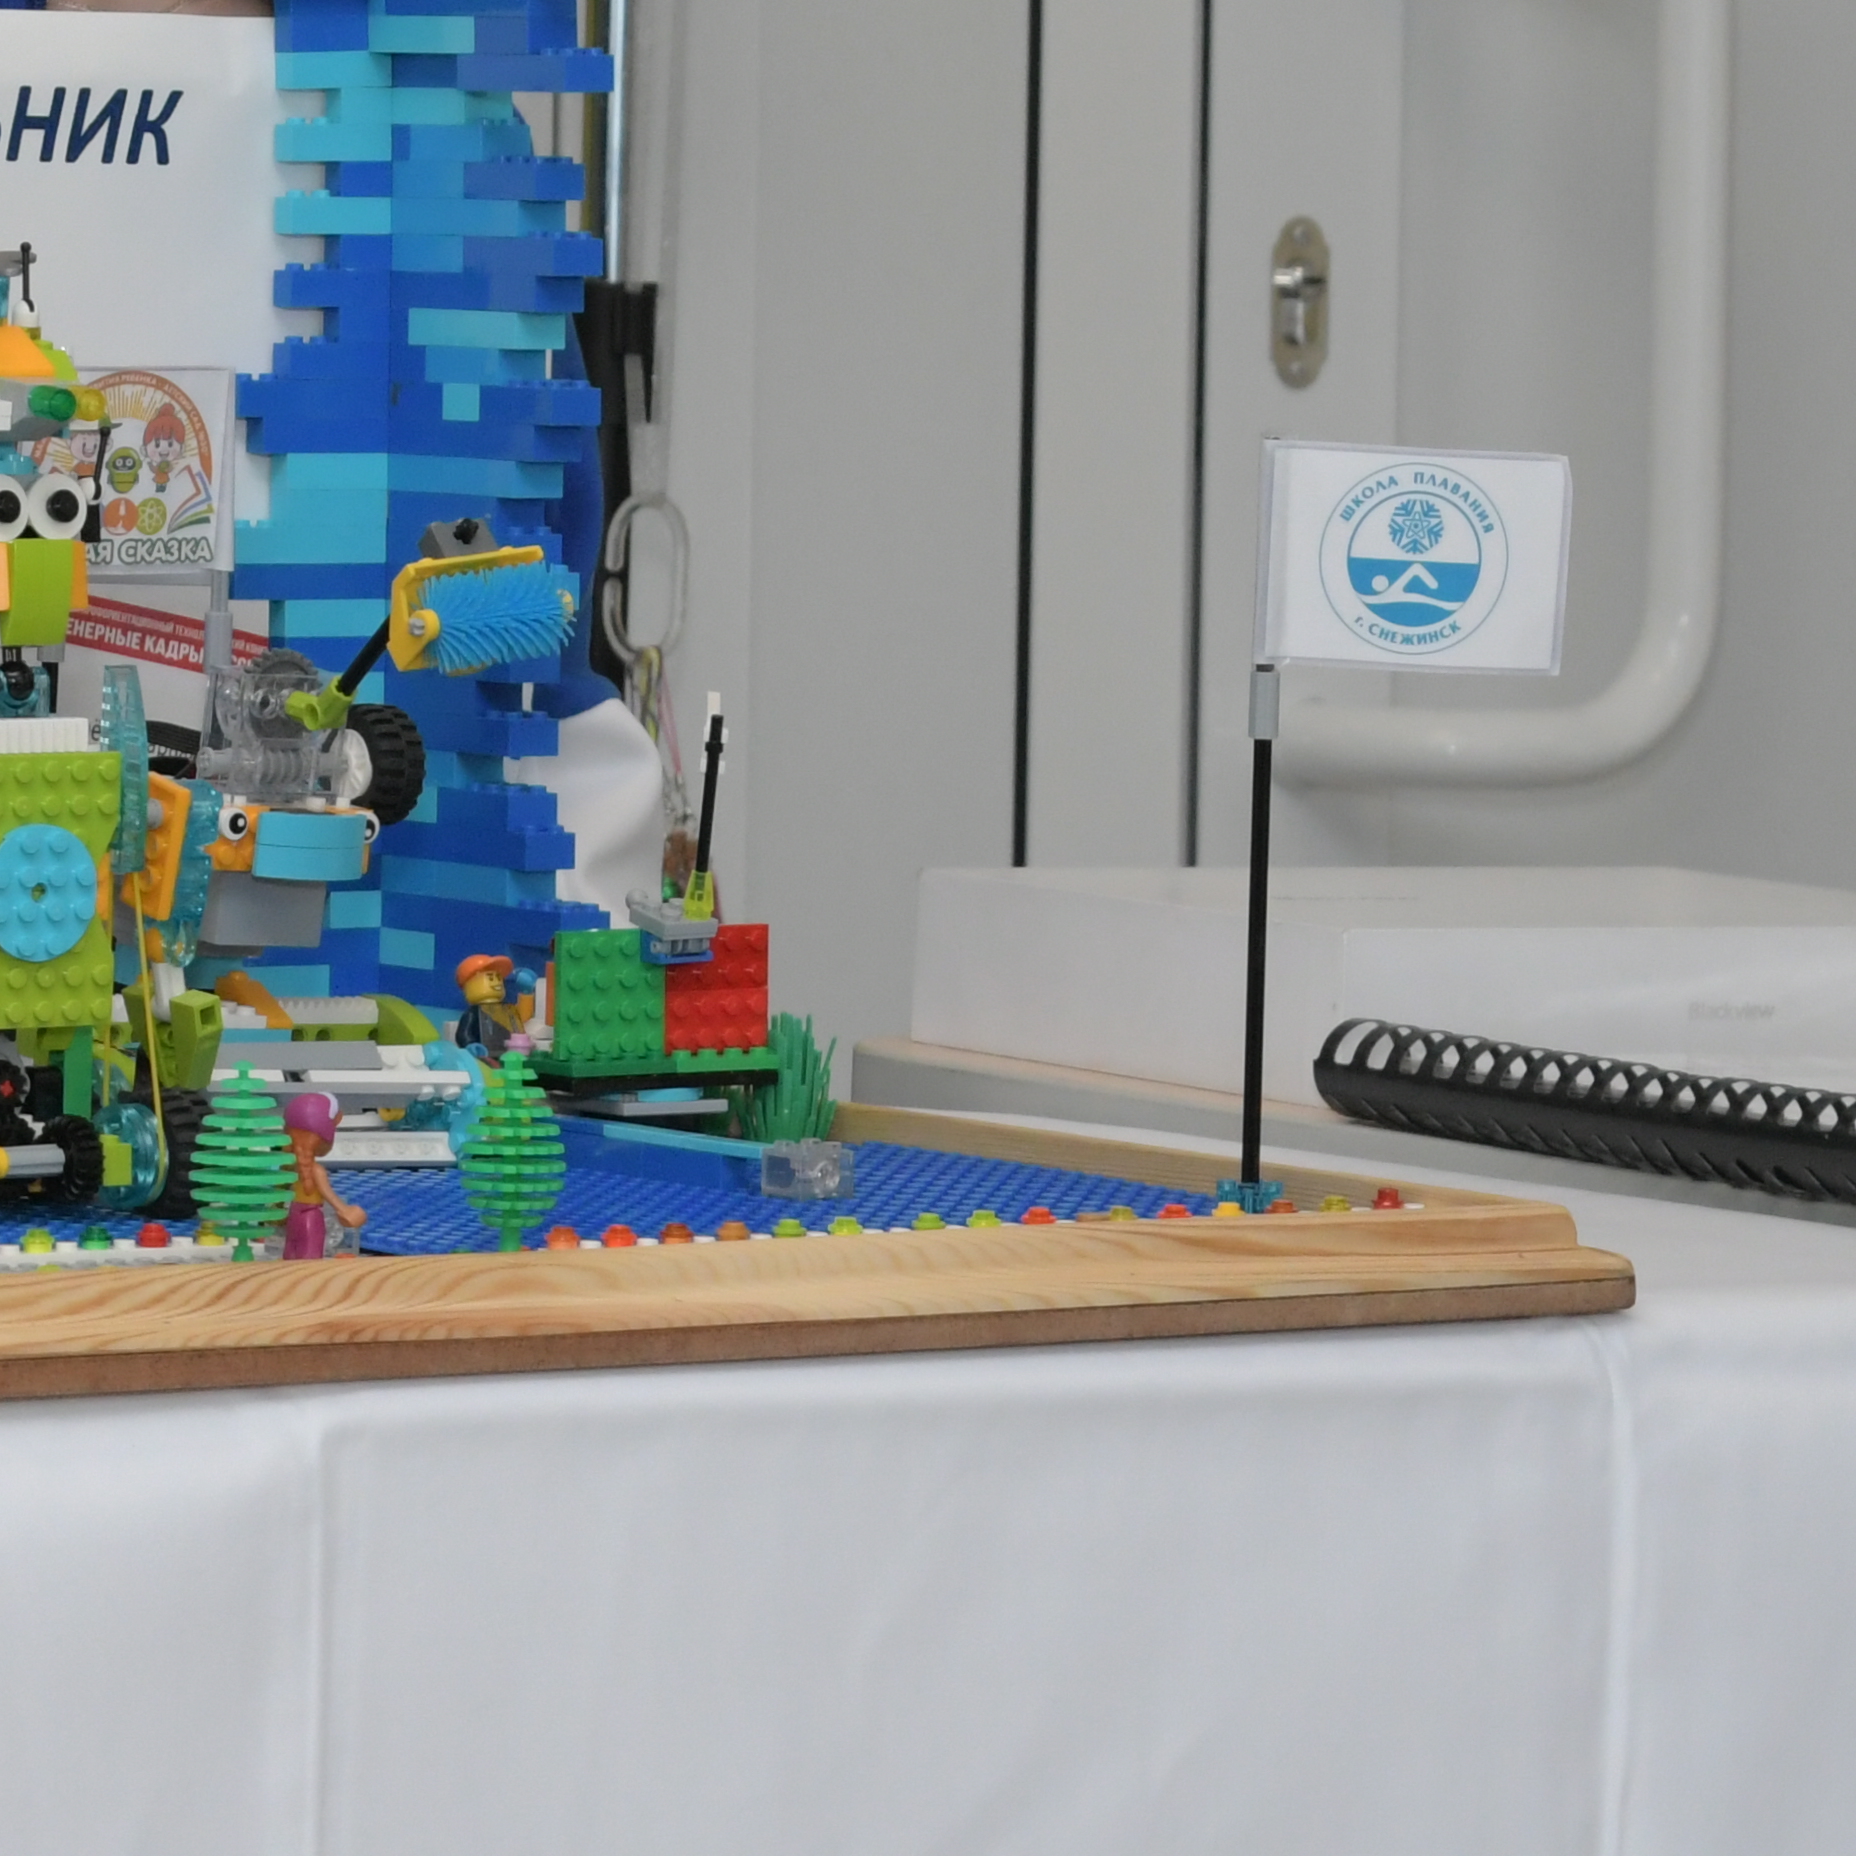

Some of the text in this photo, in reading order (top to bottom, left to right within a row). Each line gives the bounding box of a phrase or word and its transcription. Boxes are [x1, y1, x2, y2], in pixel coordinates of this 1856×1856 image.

[1339, 471, 1495, 534] ШКОЛА ПЛАВАНИЯ
[118, 535, 214, 566] СКАЗКА
[66, 617, 141, 651] ЕНЕРНЫЕ
[1368, 619, 1462, 646] СНЕЖИНСК
